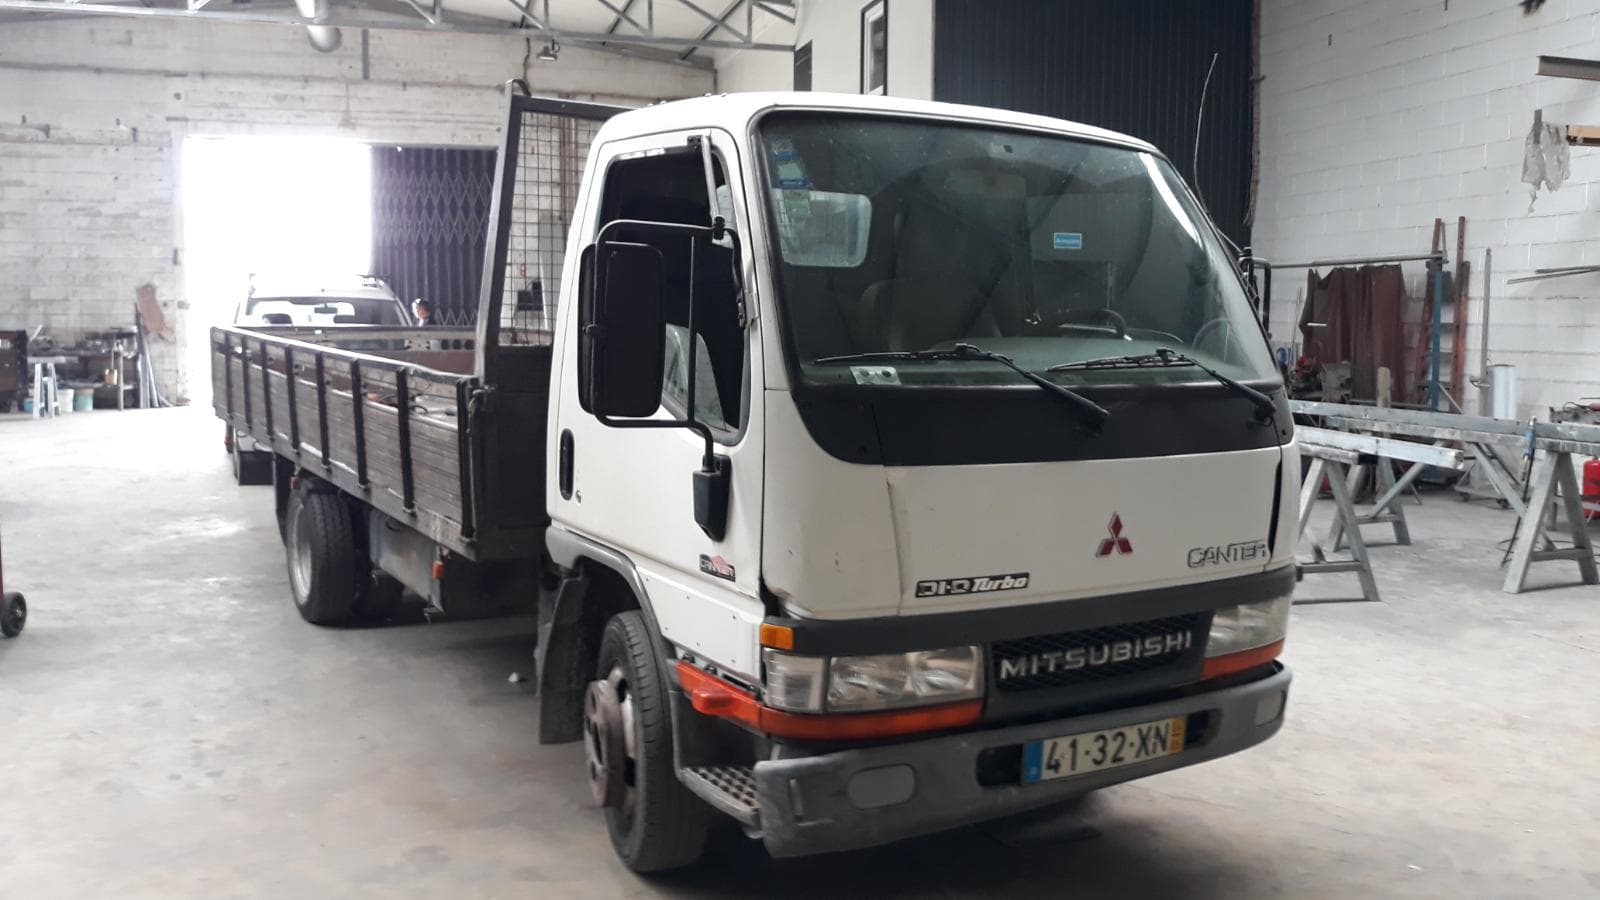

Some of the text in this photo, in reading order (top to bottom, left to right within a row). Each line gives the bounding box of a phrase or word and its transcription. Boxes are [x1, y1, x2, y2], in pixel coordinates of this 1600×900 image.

[1187, 540, 1266, 568] CANTER
[971, 575, 1028, 592] Turbo
[1001, 631, 1192, 680] MITSUBISHI
